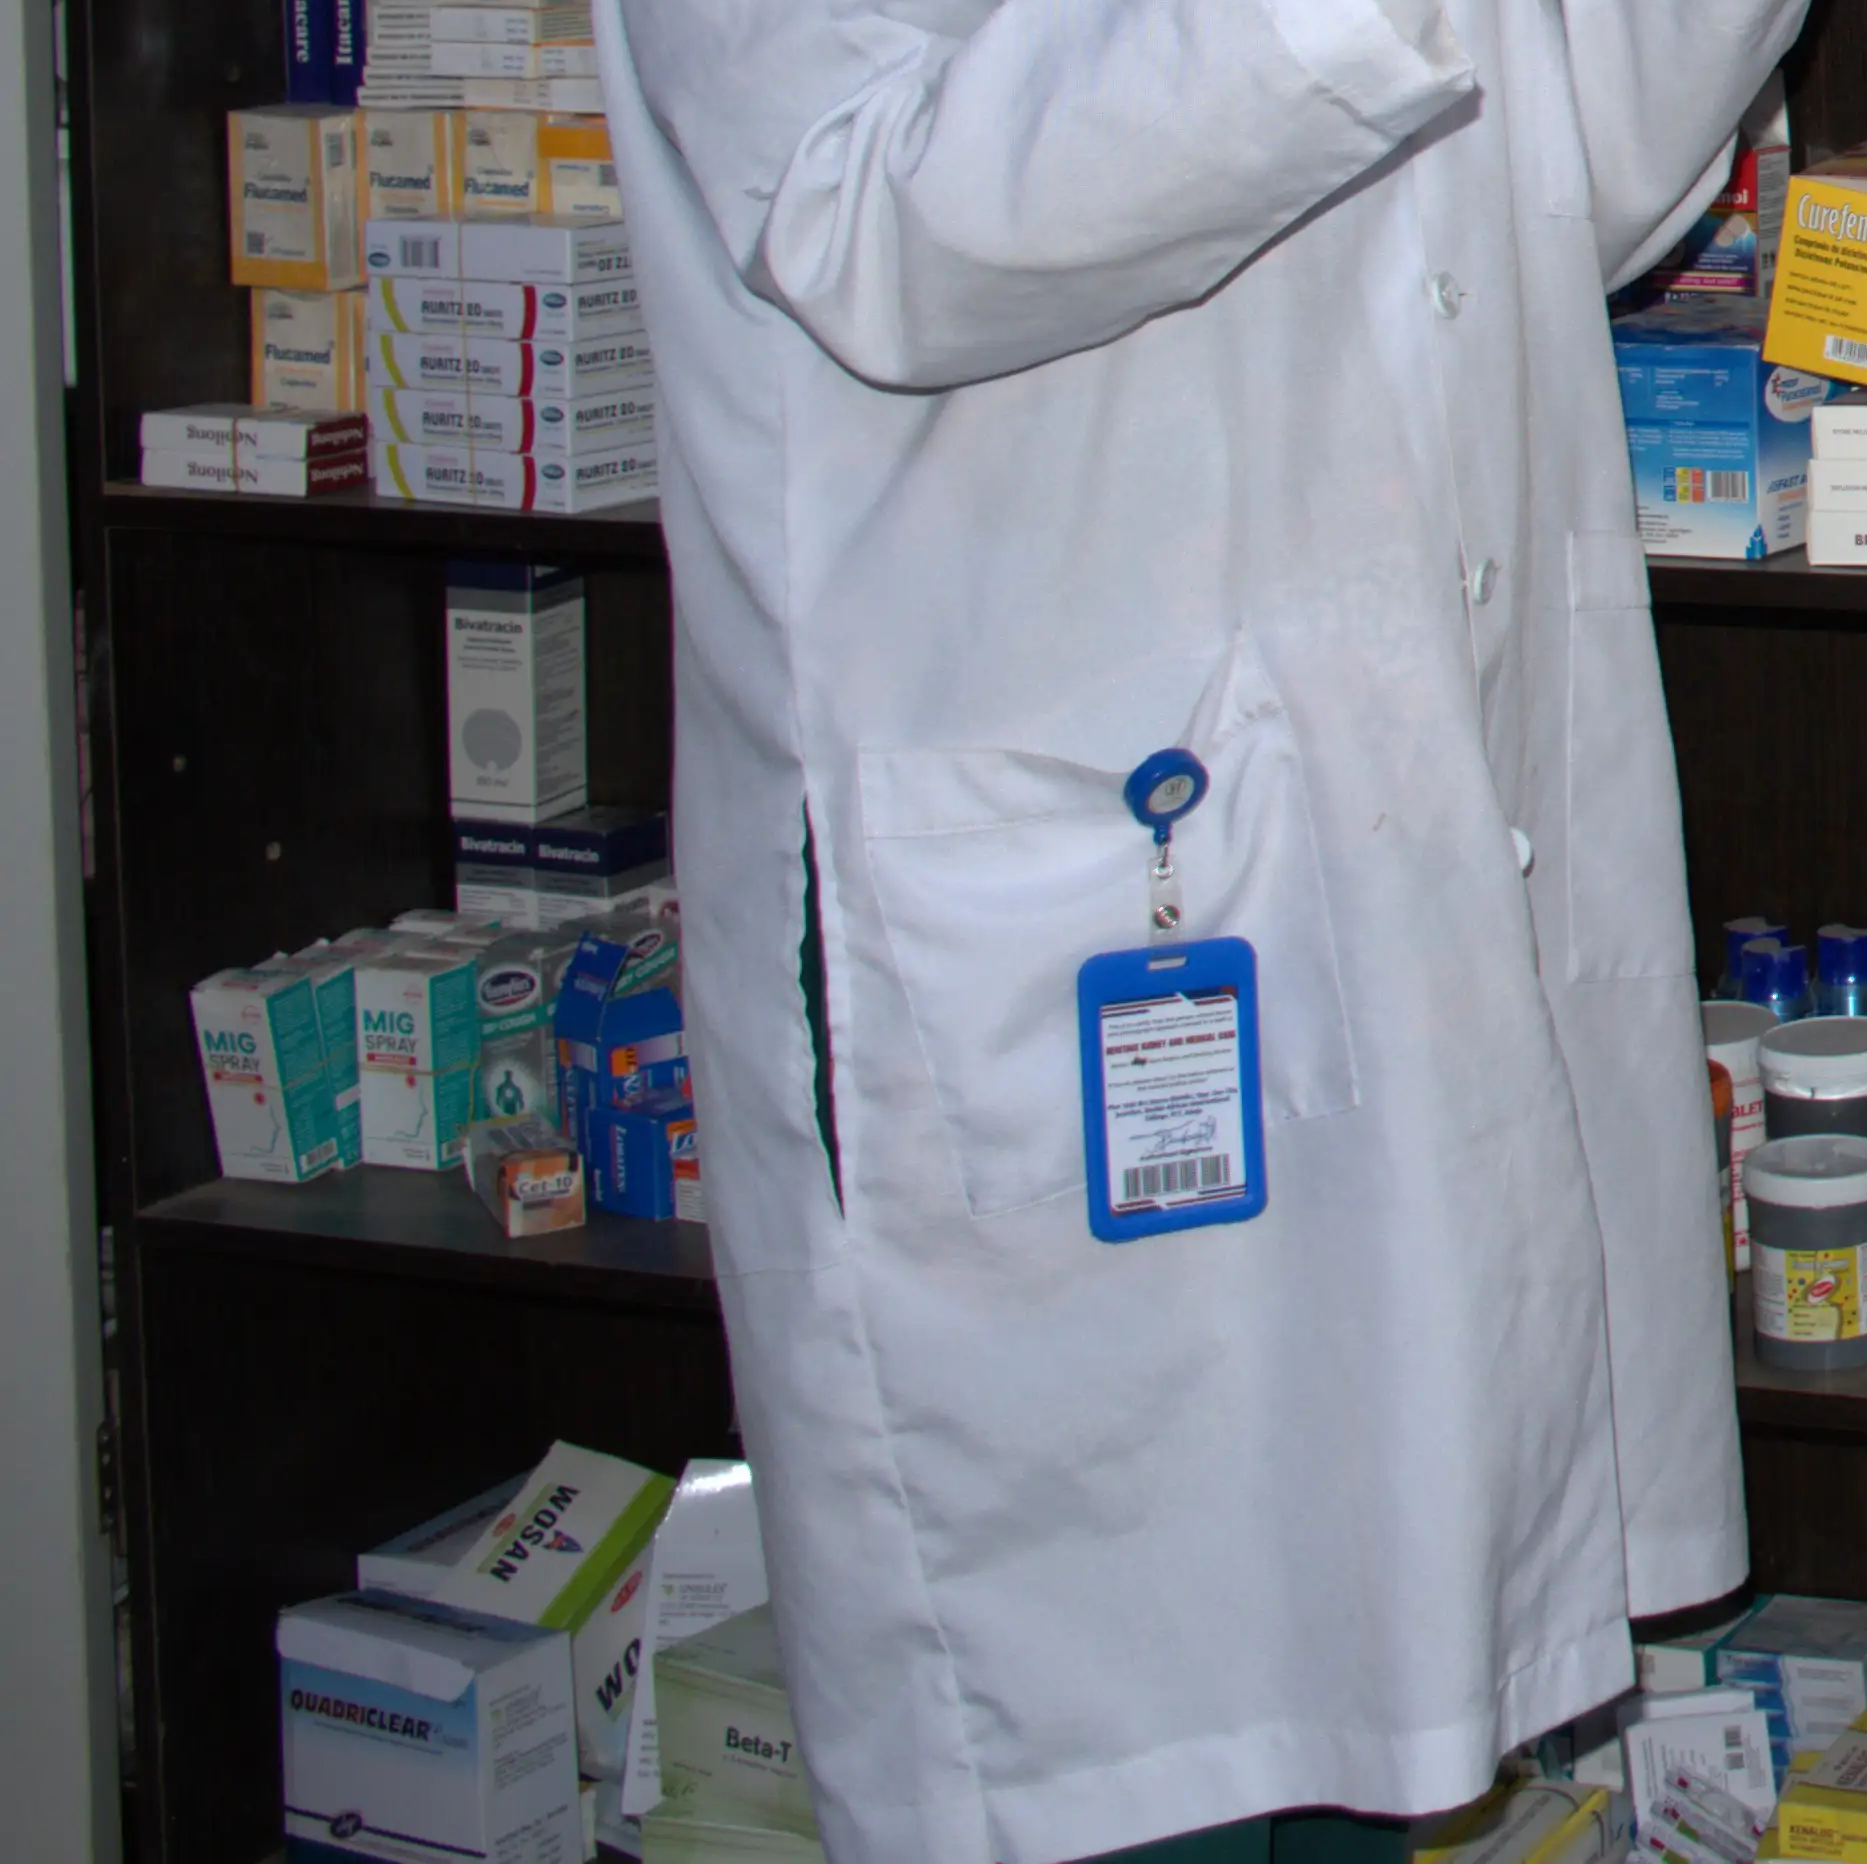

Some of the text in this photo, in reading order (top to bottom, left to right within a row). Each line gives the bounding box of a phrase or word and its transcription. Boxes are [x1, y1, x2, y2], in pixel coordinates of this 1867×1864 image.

[243, 181, 309, 203] Flucamed
[454, 618, 523, 635] Bivatracin
[362, 1010, 415, 1034] MIG
[364, 1035, 416, 1053] SPRAY
[491, 1485, 580, 1583] WOSAN
[290, 1688, 430, 1742] QUADRICLEAR
